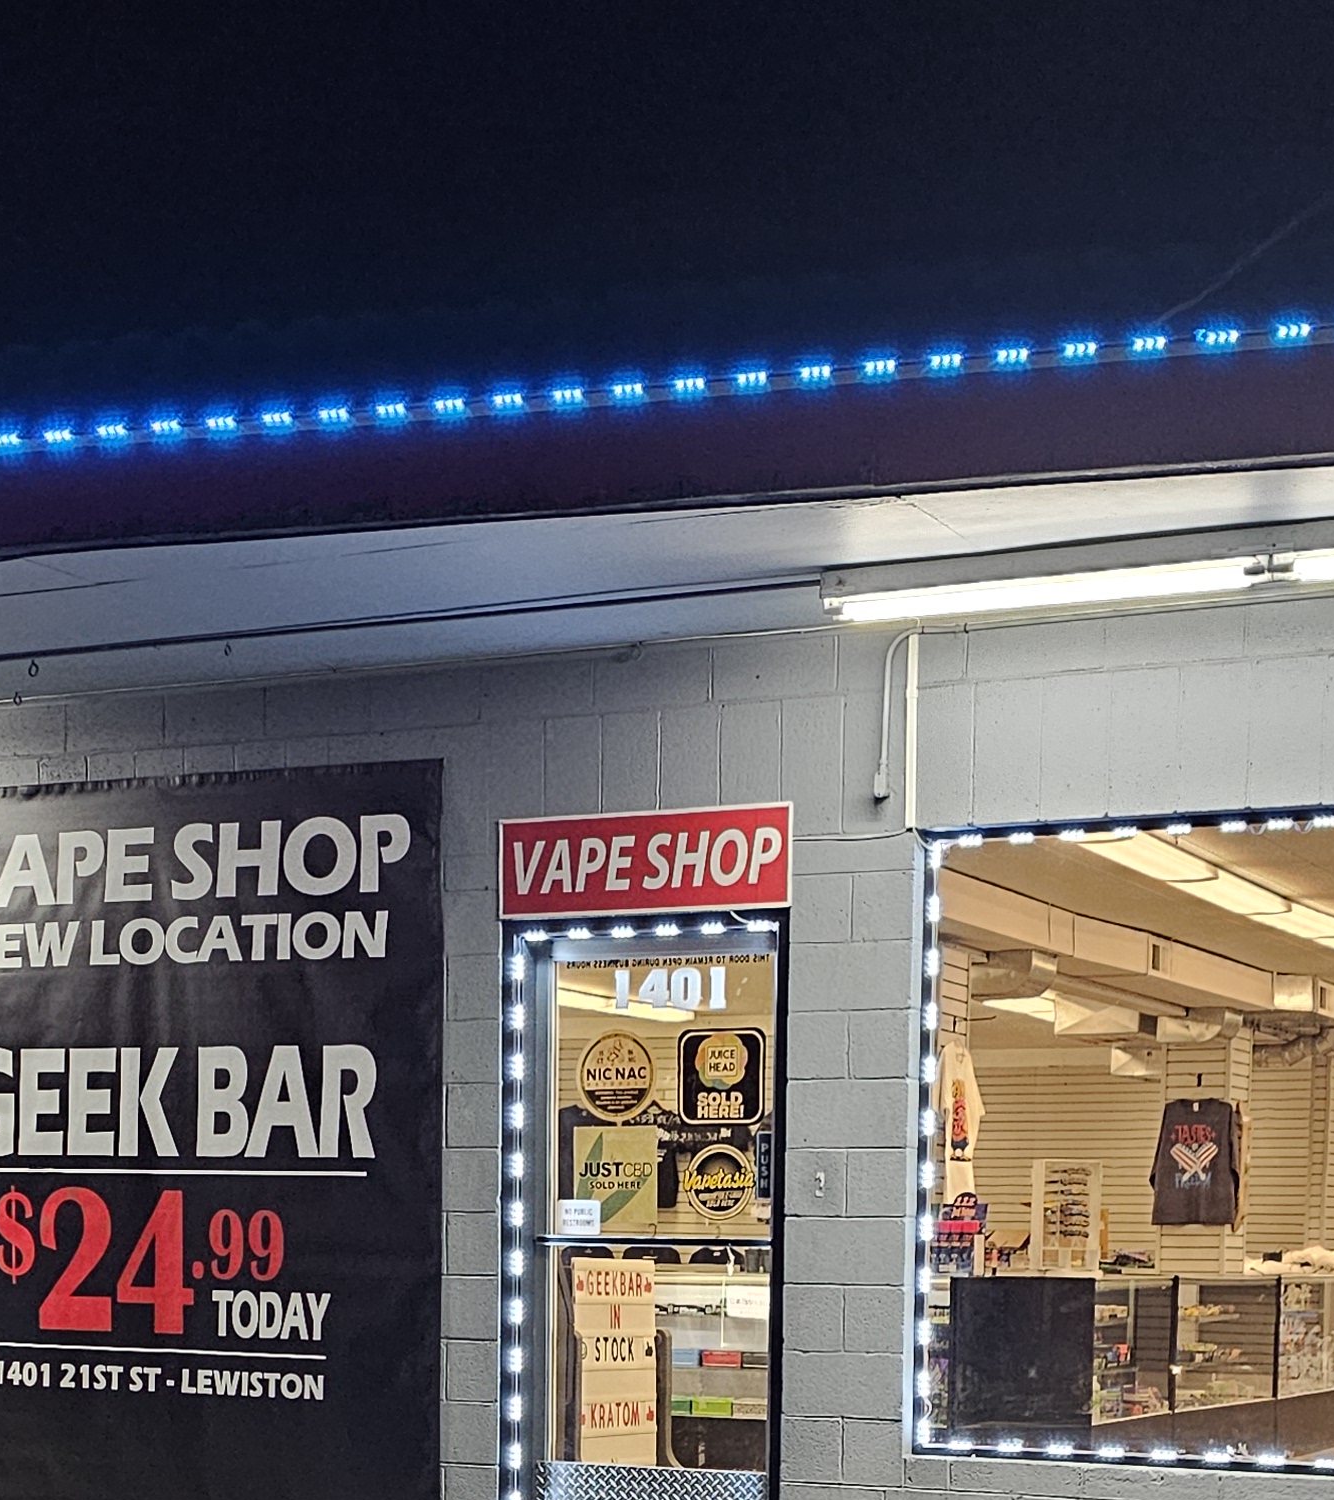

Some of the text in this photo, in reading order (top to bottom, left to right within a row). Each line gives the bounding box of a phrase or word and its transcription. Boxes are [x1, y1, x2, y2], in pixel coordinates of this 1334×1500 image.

[171, 813, 411, 900] SHOP
[513, 827, 782, 895] VAPE SHOP
[89, 910, 388, 966] LOCATION
[615, 966, 726, 1010] 1401
[709, 1049, 735, 1060] JUICE
[709, 1062, 736, 1072] HEAD
[586, 1066, 647, 1081] NIC NAC
[197, 1045, 377, 1158] BAR
[697, 1091, 743, 1107] SOLD
[697, 1104, 745, 1119] HERE!
[1174, 1124, 1212, 1146] TASTES
[684, 1167, 754, 1191] Vapetasia
[760, 1143, 769, 1189] PUSH
[589, 1181, 641, 1189] SOLD HERE
[586, 1271, 643, 1297] GEEKBAR
[212, 1290, 331, 1341] TODAY
[609, 1304, 621, 1330] IN
[595, 1337, 635, 1362] STOCK
[59, 1363, 125, 1391] 21ST
[129, 1366, 161, 1393] ST
[181, 1369, 324, 1400] LEWISTON
[590, 1402, 640, 1429] KRATOM
